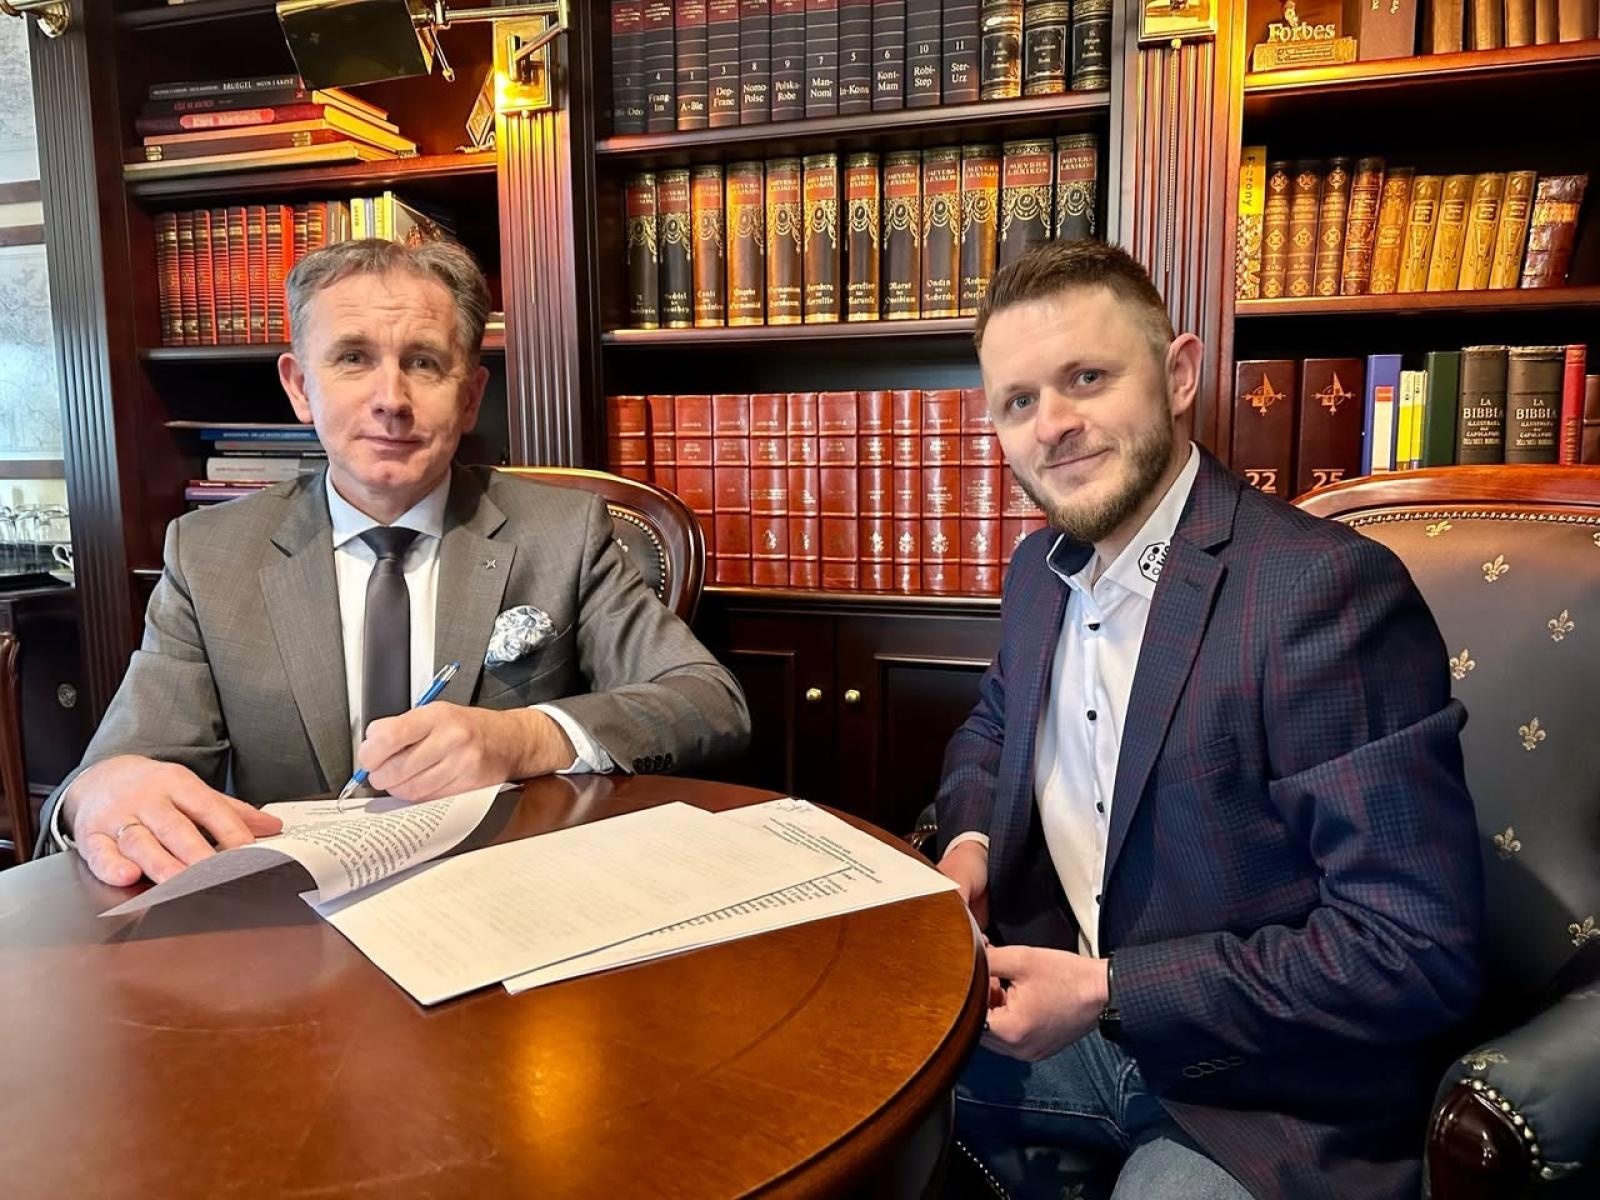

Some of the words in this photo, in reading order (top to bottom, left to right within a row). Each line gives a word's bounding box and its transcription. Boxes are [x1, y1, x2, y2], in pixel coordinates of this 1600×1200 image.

[1267, 22, 1335, 42] Forbes
[919, 44, 930, 54] 10
[955, 40, 965, 51] 11
[850, 52, 857, 61] 5
[884, 50, 891, 59] 6
[784, 59, 791, 69] 9
[818, 56, 824, 65] 7
[752, 62, 757, 71] 8
[655, 72, 661, 80] 4
[812, 77, 833, 87] Man-
[1010, 161, 1047, 169] MEYERS
[1008, 168, 1048, 176] LEXIKON
[1480, 398, 1491, 406] LA
[1533, 398, 1544, 406] LA
[1463, 407, 1504, 419] BIBBIA
[1515, 408, 1557, 420] BIBBIA
[1245, 472, 1276, 490] 22
